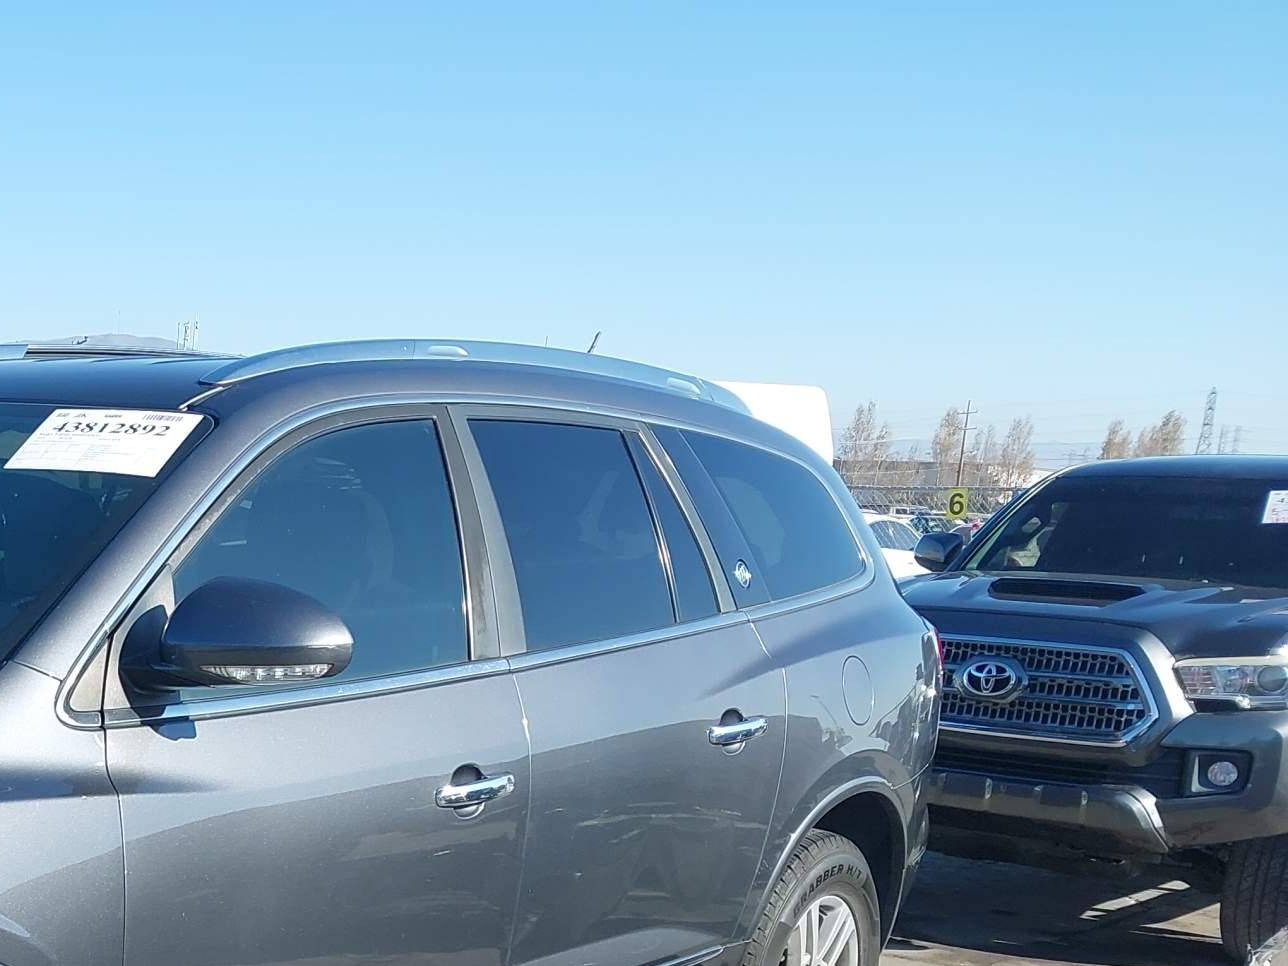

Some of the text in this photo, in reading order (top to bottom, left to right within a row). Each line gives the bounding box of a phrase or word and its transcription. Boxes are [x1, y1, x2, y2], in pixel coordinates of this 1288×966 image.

[53, 421, 171, 436] 43812892
[949, 492, 965, 516] 6
[792, 863, 863, 919] GRABBER H/T
